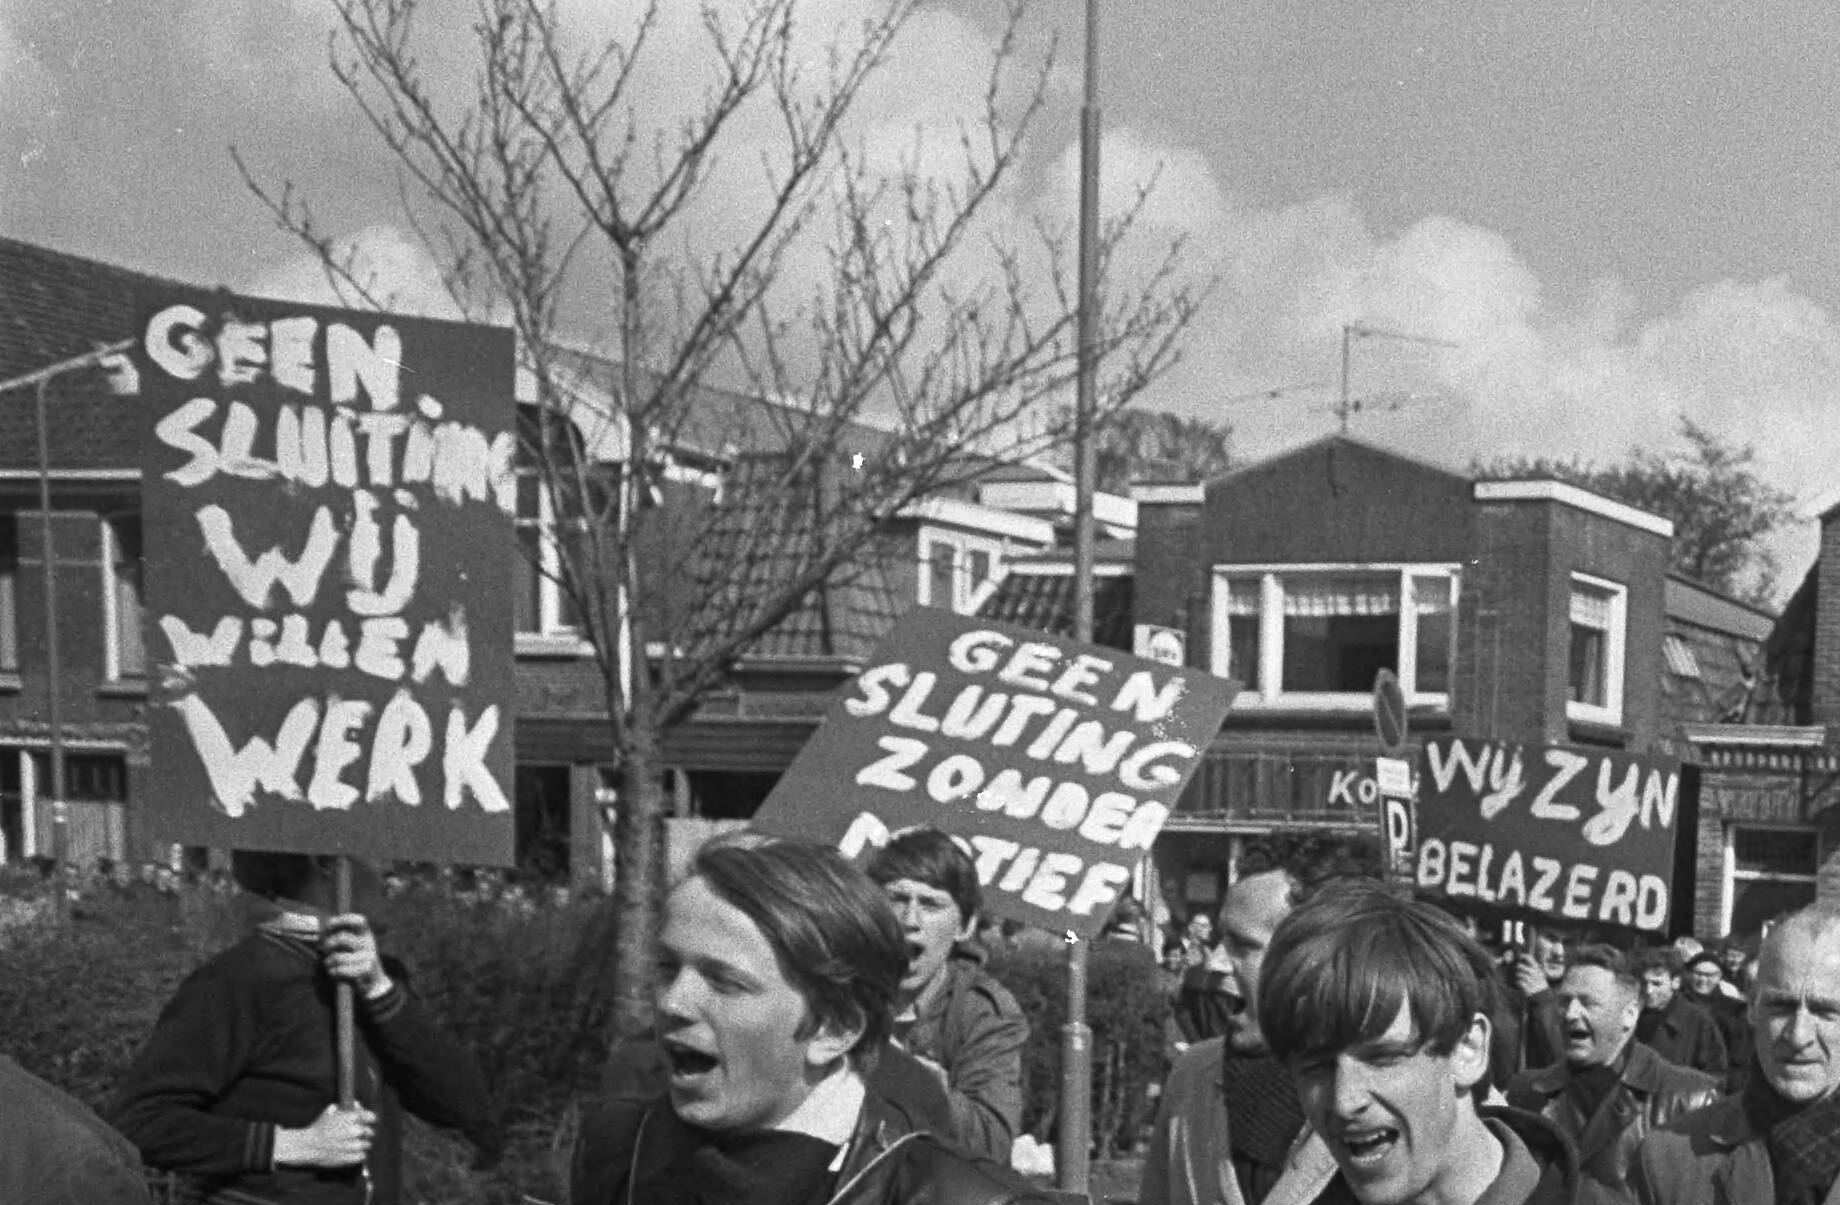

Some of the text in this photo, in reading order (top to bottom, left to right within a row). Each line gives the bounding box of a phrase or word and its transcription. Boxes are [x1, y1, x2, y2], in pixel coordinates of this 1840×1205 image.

[145, 305, 400, 410] GEEN
[844, 662, 1197, 792] SLUTING
[949, 630, 1187, 723] GEEN
[170, 688, 510, 818] WERK
[855, 735, 1170, 852] ZONDER
[838, 811, 1129, 916] MTIEF
[1417, 838, 1668, 930] BELAZERD
